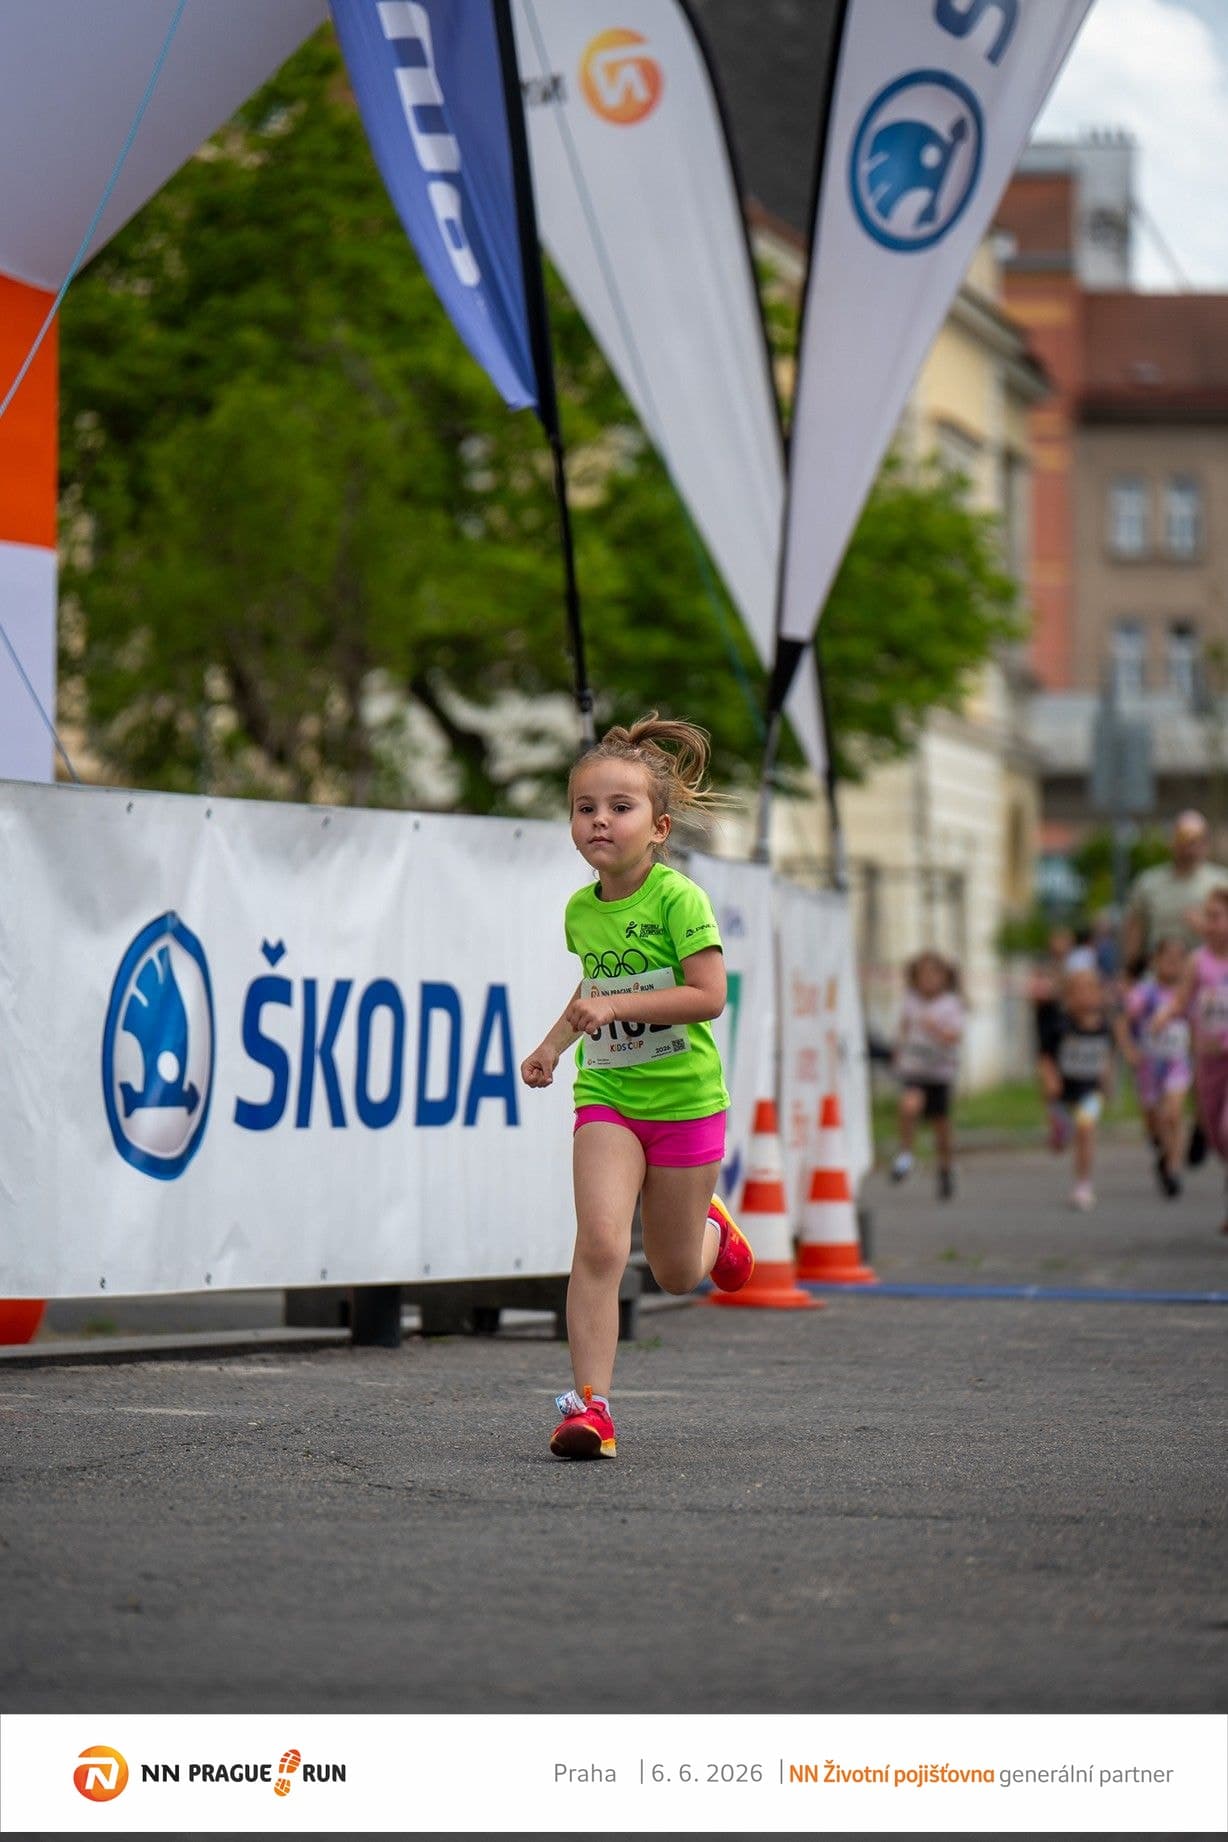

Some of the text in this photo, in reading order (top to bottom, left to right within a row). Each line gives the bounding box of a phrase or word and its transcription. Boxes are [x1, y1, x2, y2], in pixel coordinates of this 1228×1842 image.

[640, 983, 655, 992] RUN
[233, 938, 521, 1131] ŠKODA
[609, 1040, 644, 1053] KIDS CUP
